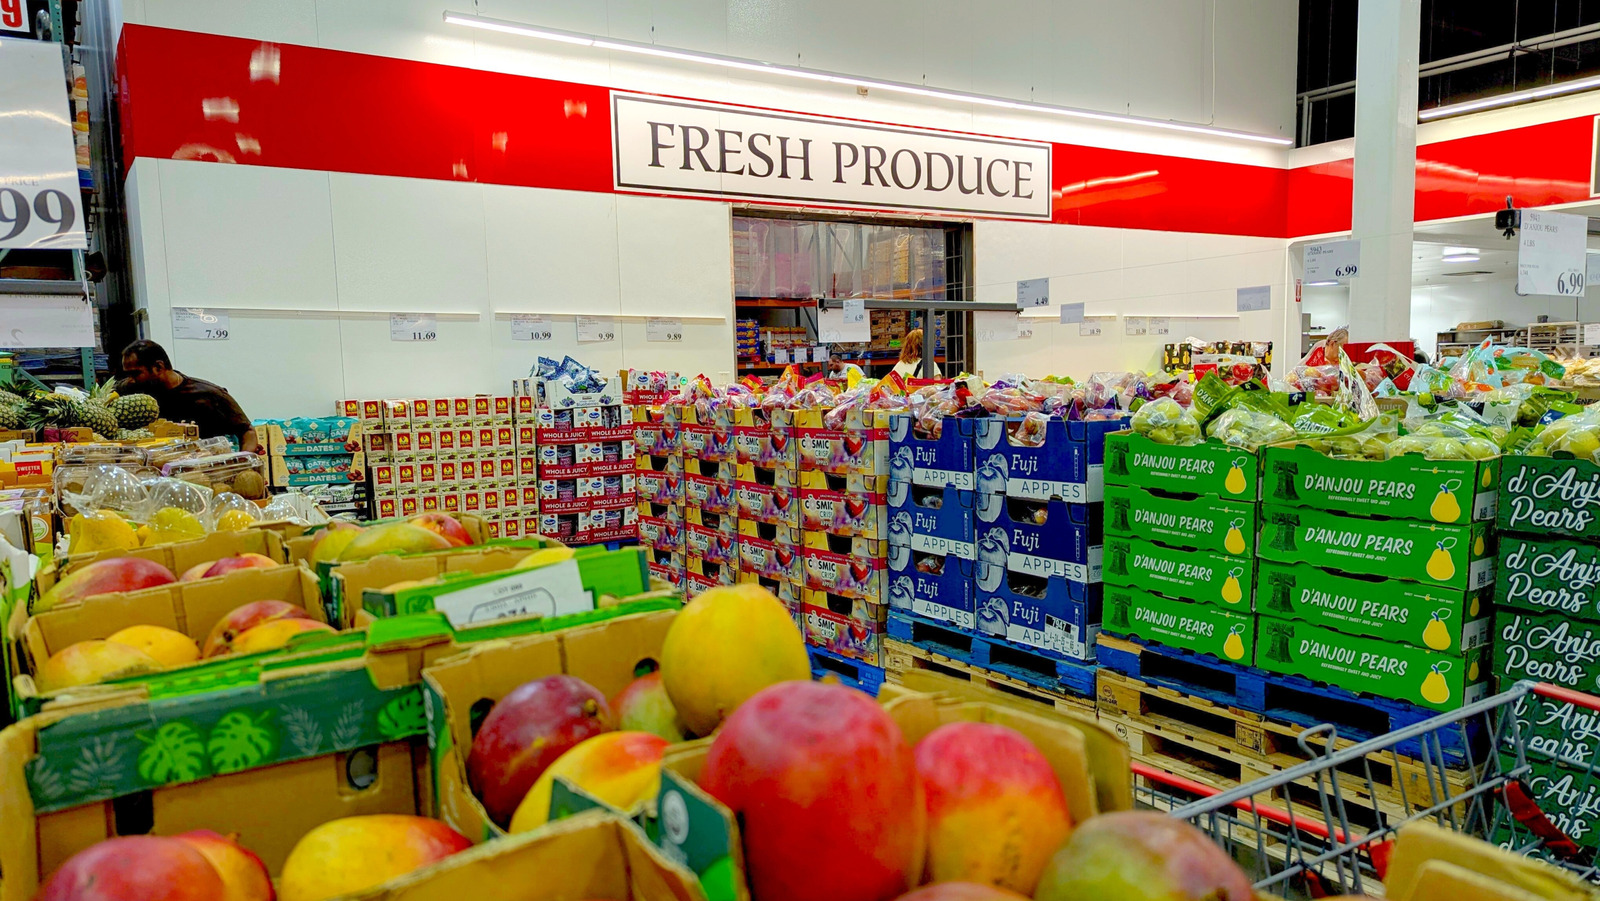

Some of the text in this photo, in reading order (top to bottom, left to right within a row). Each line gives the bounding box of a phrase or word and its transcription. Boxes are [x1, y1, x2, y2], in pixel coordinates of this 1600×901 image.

[646, 121, 1035, 200] FRESH PRODUCE
[1335, 265, 1358, 277] 6.99
[1557, 272, 1584, 295] 6.99
[206, 329, 228, 339] 7.99
[412, 331, 436, 340] 11.69
[530, 332, 552, 340] 10.99
[598, 332, 614, 340] 9.99
[915, 446, 936, 465] Fuji
[1011, 454, 1038, 476] Fuji
[1133, 453, 1215, 474] D'ANJOU PEARS
[924, 470, 969, 486] APPLES
[1304, 473, 1416, 500] D'ANJOU PEARS
[1021, 481, 1080, 498] APPLES
[915, 512, 937, 531] Fuji
[1134, 508, 1214, 534] D'ANJOU PEARS
[1509, 495, 1594, 532] Pears
[923, 537, 970, 556] APPLES
[1012, 529, 1040, 552] Fuji
[1304, 527, 1414, 556] D'ANJOU PEARS
[1022, 556, 1082, 578] APPLES
[1134, 554, 1213, 582] D'ANJOU PEARS
[916, 578, 938, 599] Fuji
[1507, 572, 1590, 613] Pears
[925, 603, 969, 625] APPLES
[1012, 601, 1040, 624] Fuji
[1300, 588, 1409, 624] D'ANJOU PEARS
[1052, 618, 1066, 631] 7947
[1135, 608, 1214, 637] D'ANJOU PEARS
[1300, 640, 1408, 676] D'ANJOU PEARS
[1505, 644, 1587, 686] Pears
